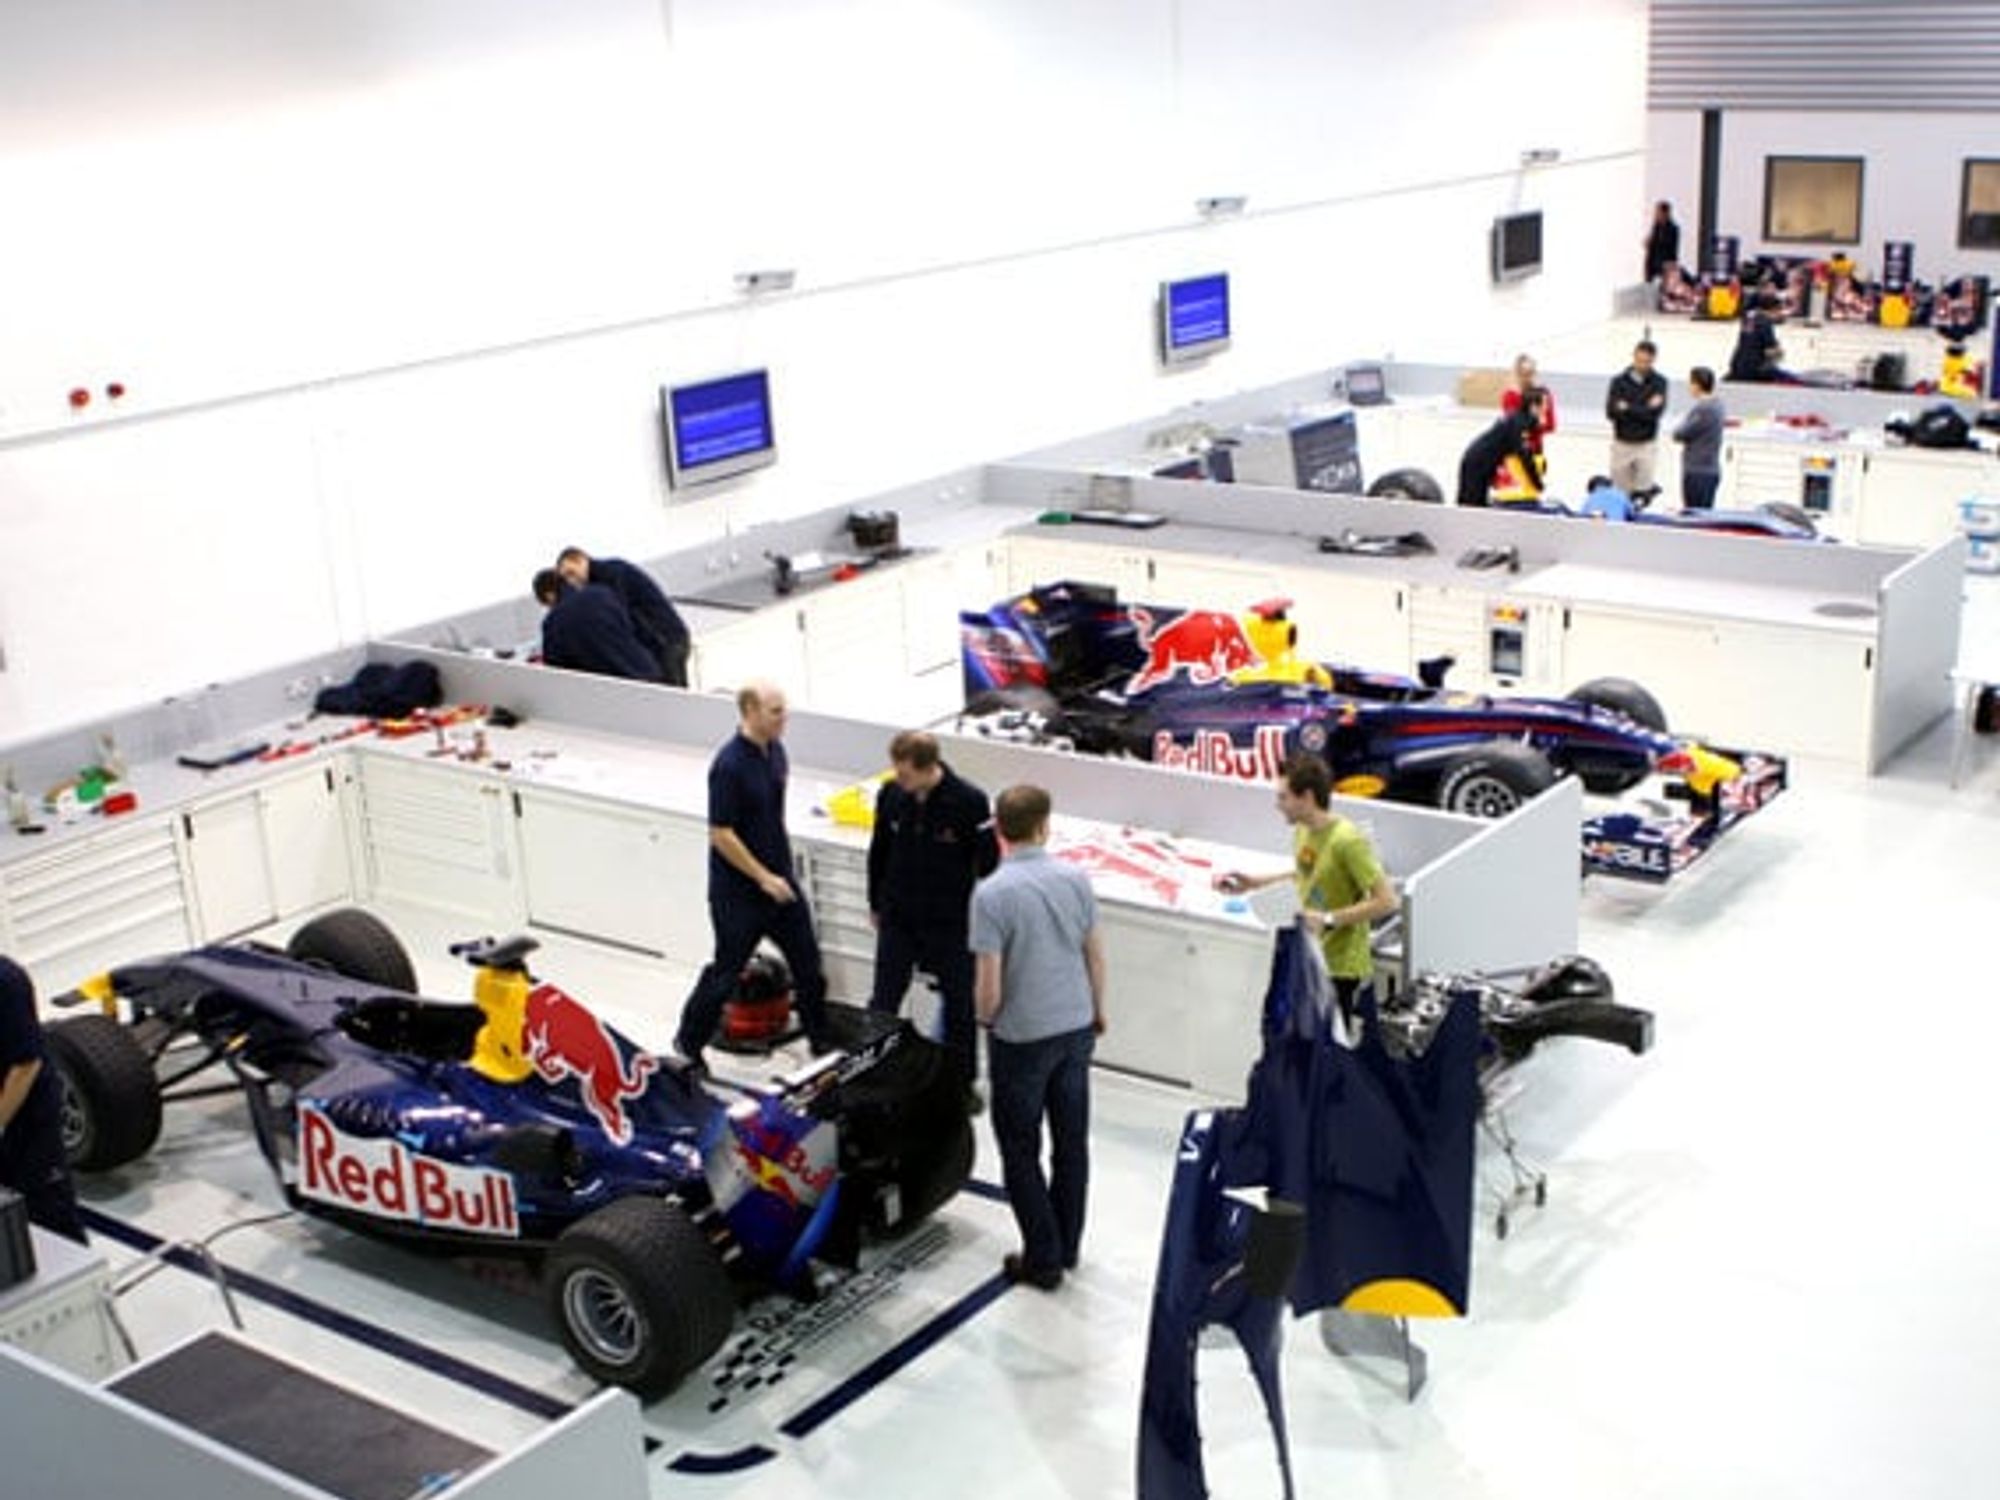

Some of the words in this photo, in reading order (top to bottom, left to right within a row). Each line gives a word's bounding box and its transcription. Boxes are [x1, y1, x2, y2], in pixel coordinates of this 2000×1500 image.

[1210, 728, 1284, 781] Bull
[302, 1108, 406, 1213] Red
[412, 1157, 516, 1230] Bull
